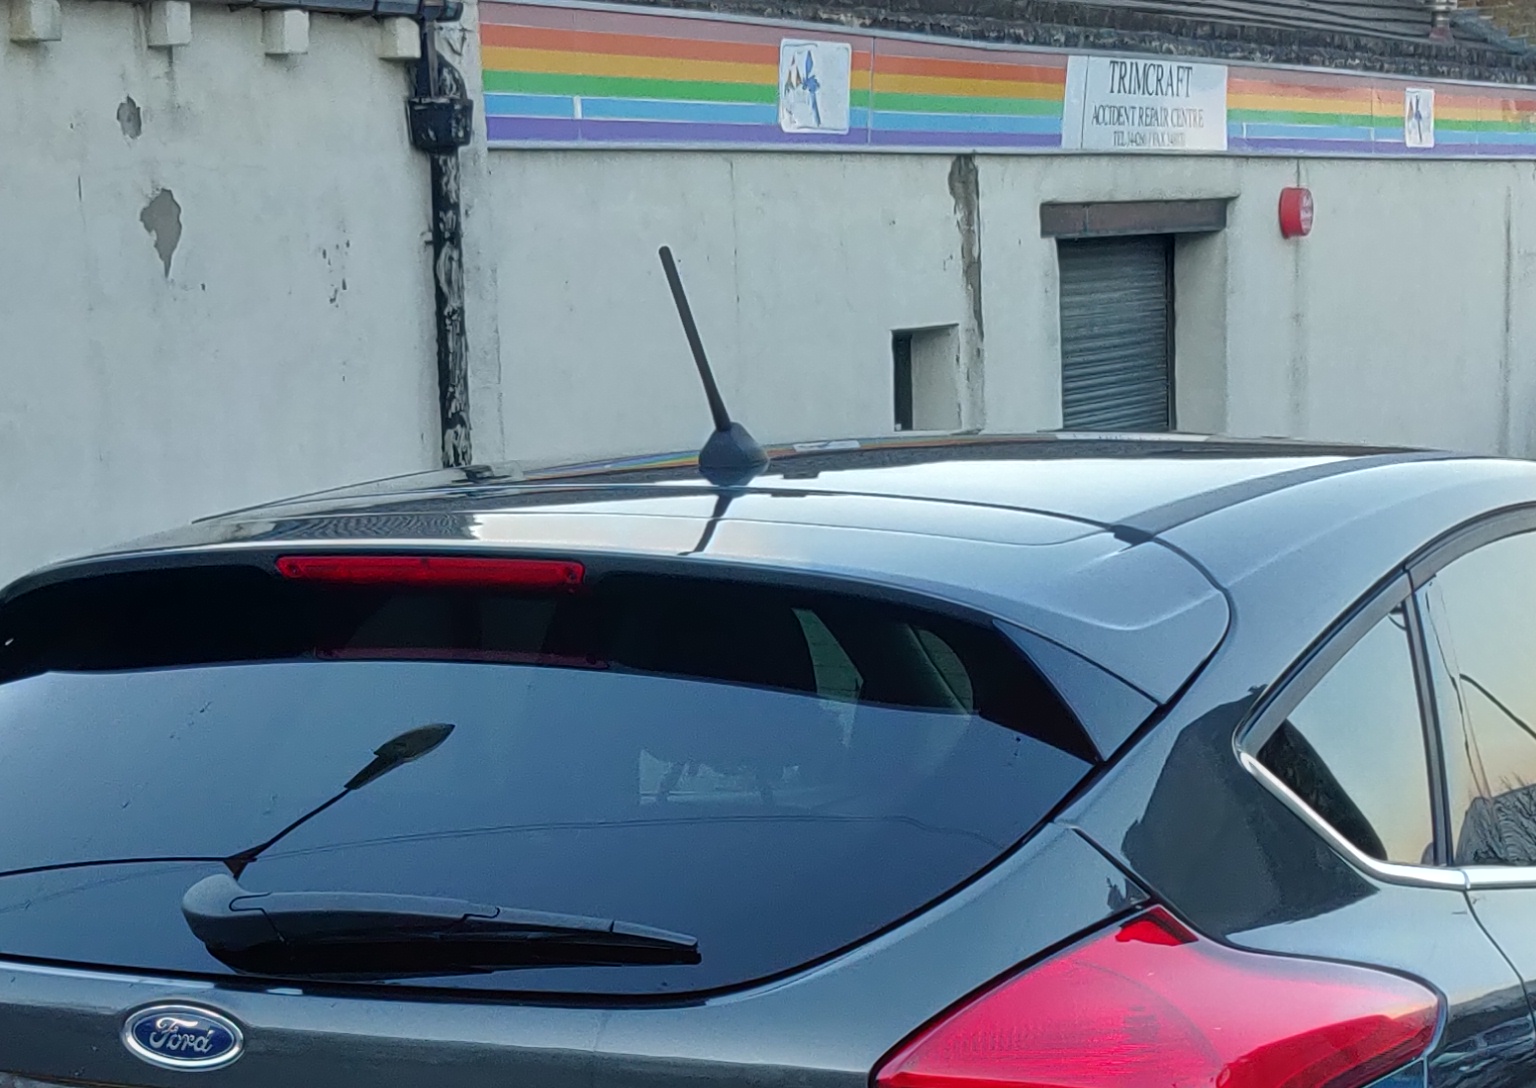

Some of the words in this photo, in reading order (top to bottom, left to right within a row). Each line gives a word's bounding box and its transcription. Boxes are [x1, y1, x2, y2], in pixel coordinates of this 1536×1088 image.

[1109, 60, 1193, 98] TRIMCRAFT
[1091, 105, 1137, 126] ACCIDENT
[1138, 106, 1169, 127] REPAIR
[1170, 108, 1204, 128] CENTRE
[149, 1016, 216, 1053] Ford
